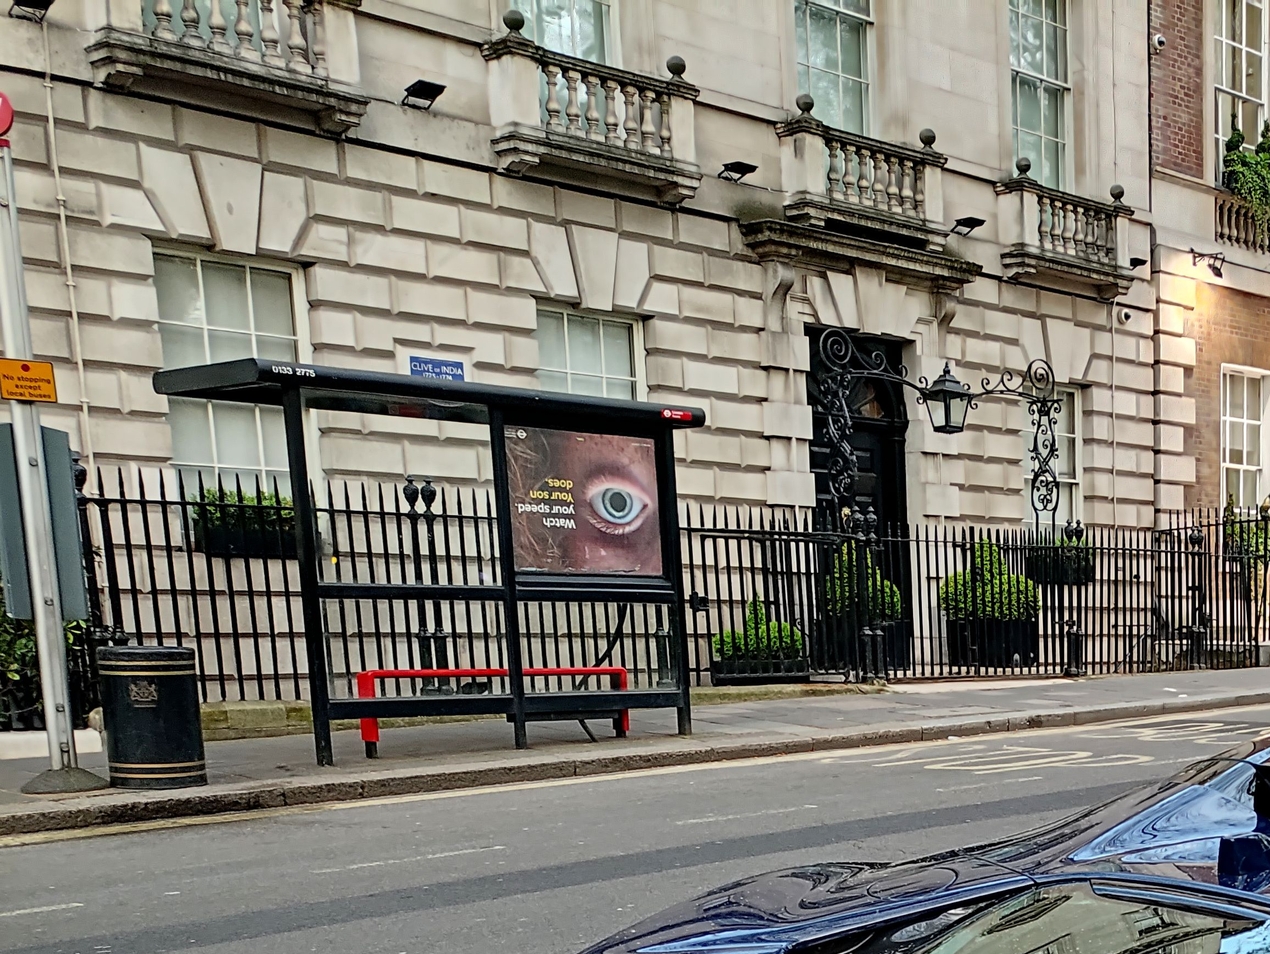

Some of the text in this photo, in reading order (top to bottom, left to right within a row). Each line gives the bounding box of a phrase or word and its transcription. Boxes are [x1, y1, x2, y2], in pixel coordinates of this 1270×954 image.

[272, 365, 316, 378] 0133 2775
[411, 361, 434, 373] CLIVE
[441, 366, 463, 376] INDIA
[17, 375, 51, 384] stopping
[6, 389, 52, 399] local buses
[545, 478, 574, 490] does.
[529, 490, 575, 503] Your son
[514, 502, 576, 515] your speed.
[542, 517, 577, 530] Watch
[820, 744, 1155, 775] STOP
